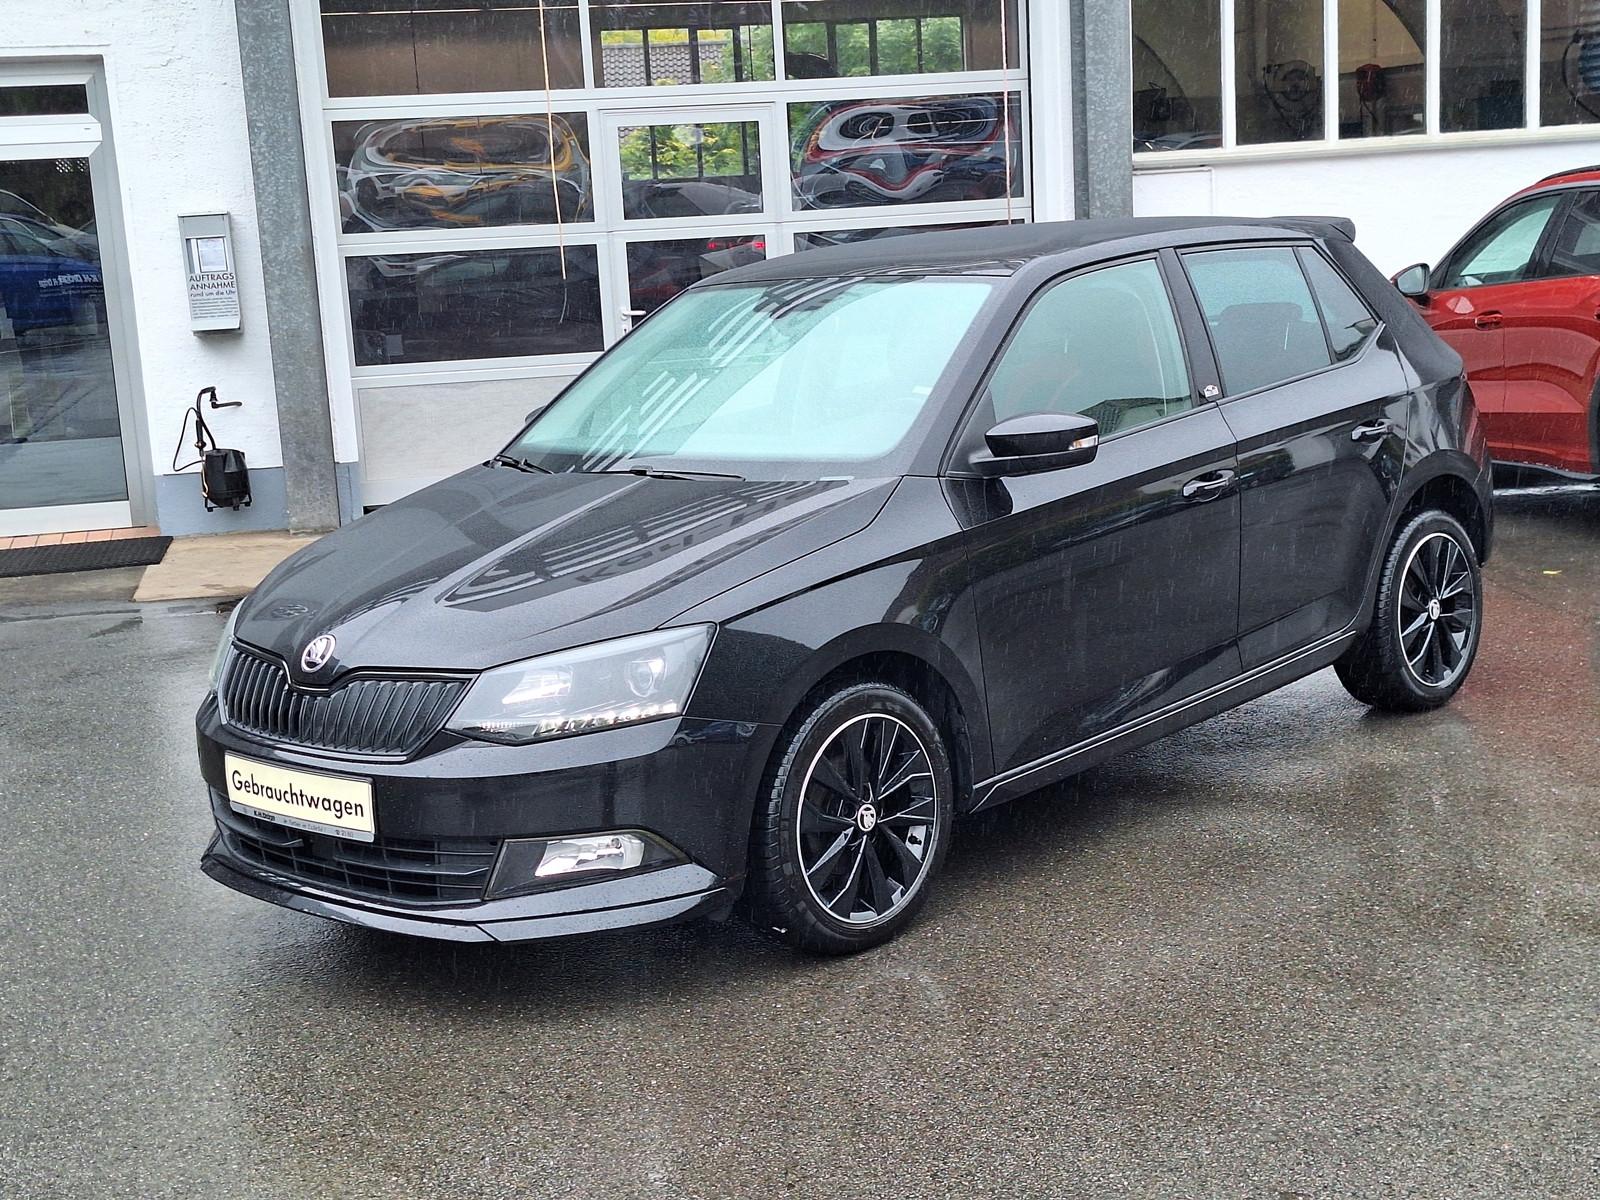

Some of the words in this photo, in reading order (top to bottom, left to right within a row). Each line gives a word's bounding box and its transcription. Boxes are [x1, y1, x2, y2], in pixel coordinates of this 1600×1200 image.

[189, 272, 235, 282] AUFTRAGS
[190, 281, 236, 290] ANNAHME
[232, 769, 364, 819] Gebrauchtwagen
